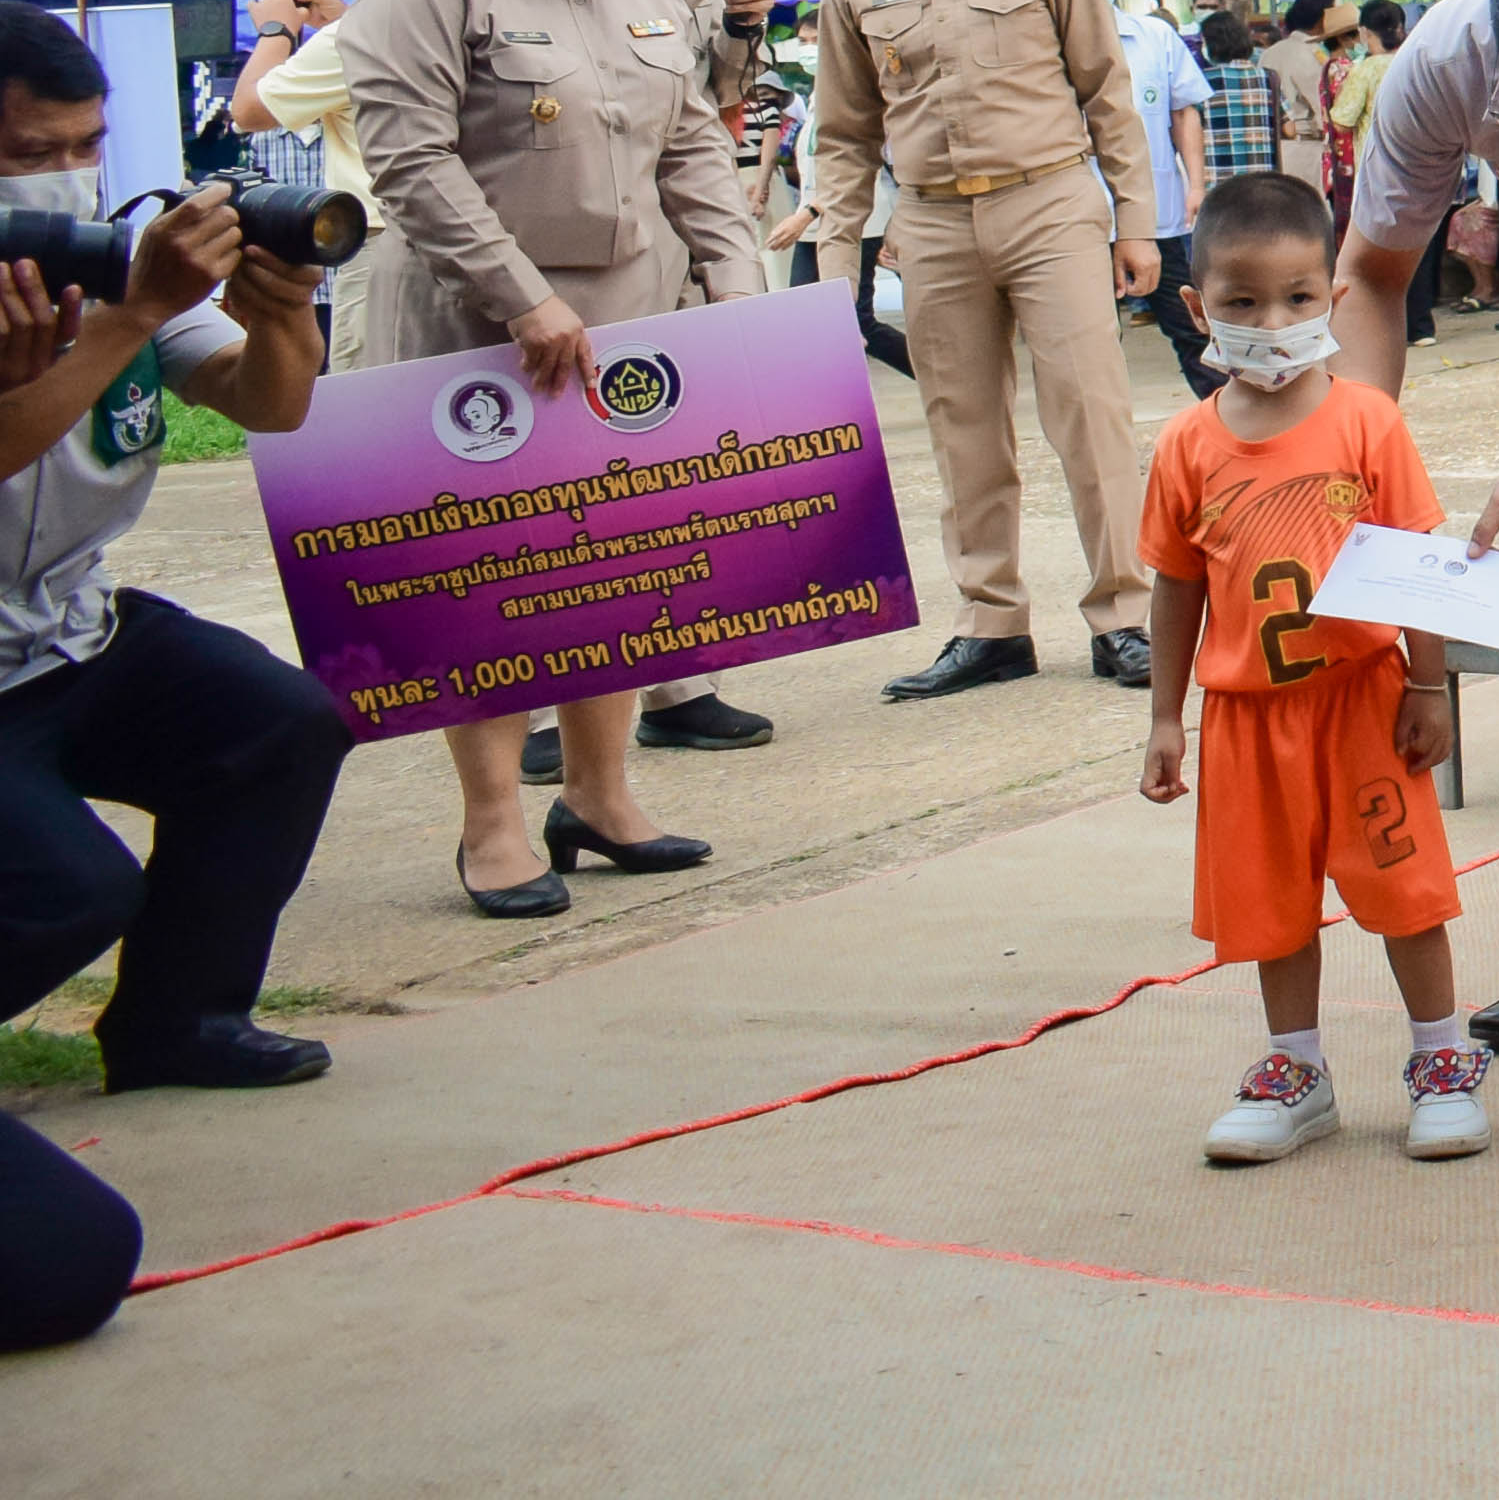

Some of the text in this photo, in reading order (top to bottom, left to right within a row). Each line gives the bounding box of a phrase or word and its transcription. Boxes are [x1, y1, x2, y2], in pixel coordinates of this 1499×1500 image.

[293, 423, 862, 558] การมอบเงินกองทุนพัฒนาเด็กชนบท
[501, 551, 712, 619] สยามบรมราชกุมารี
[1252, 557, 1329, 687] 2
[350, 580, 879, 725] ทุนละ 1,000 บาท (หนึ่งพันบาทถ้วน)
[1354, 776, 1417, 869] 2
